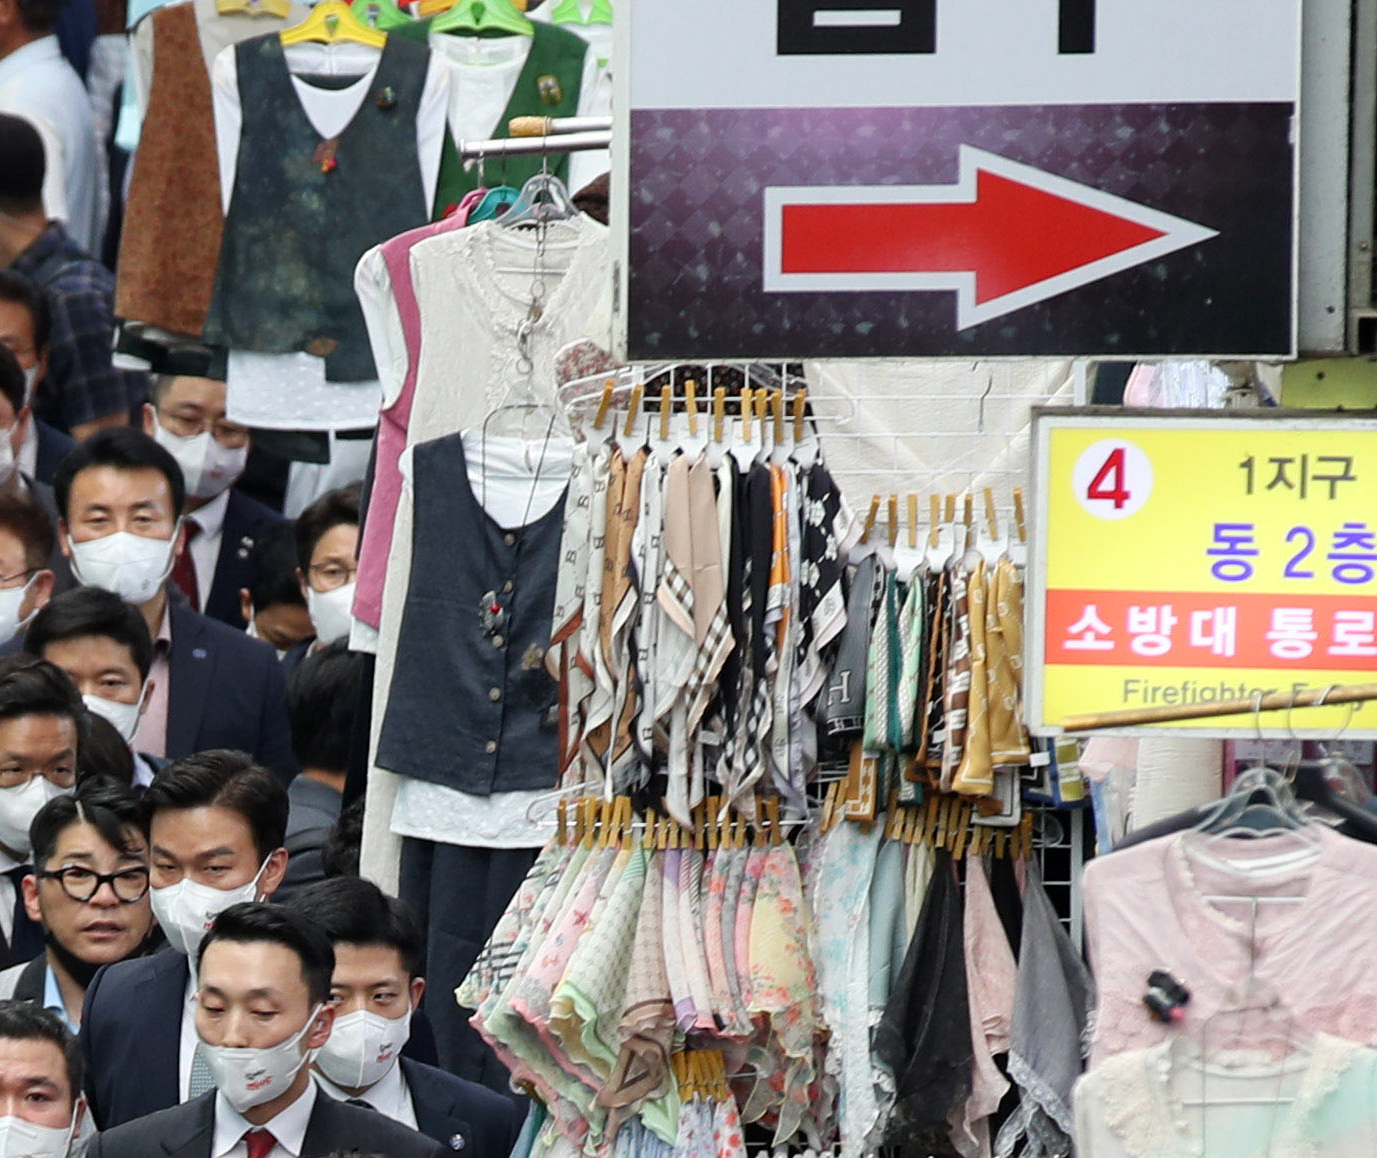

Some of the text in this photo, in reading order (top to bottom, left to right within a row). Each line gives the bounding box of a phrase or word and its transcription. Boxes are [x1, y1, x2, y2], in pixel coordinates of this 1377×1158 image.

[1086, 448, 1131, 509] 4
[1238, 453, 1358, 500] 1지구
[1206, 522, 1377, 585] 동 2층
[1062, 604, 1377, 660] 소방대 통로
